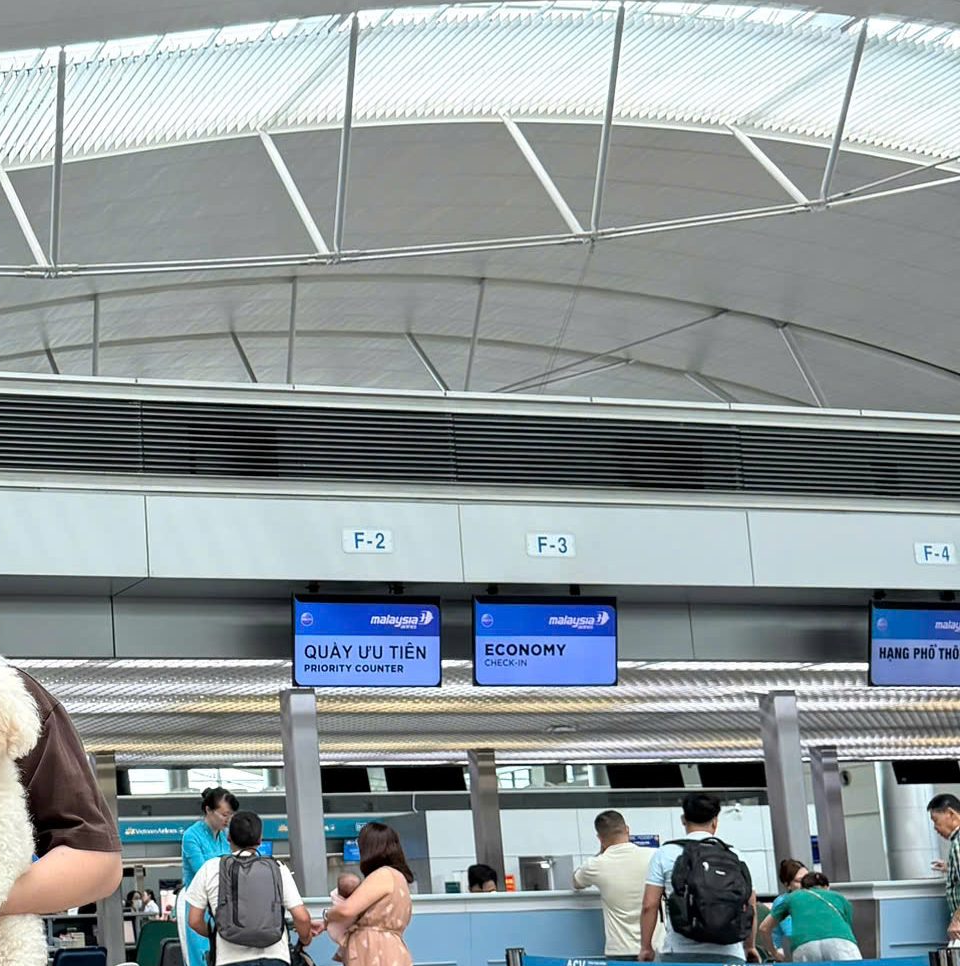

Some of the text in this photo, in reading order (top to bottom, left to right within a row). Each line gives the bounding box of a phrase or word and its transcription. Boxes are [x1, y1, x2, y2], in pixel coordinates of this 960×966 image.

[354, 531, 386, 550] F-2
[537, 535, 569, 554] F-3
[923, 545, 950, 562] F-4
[370, 614, 419, 628] malaysia
[548, 614, 595, 629] malaysia
[389, 641, 427, 660] TIÊN
[484, 643, 567, 657] ECONOMY
[879, 646, 910, 662] HẠNG
[304, 663, 404, 674] PRIORITY COUNTER
[484, 658, 528, 667] CHECK-IN
